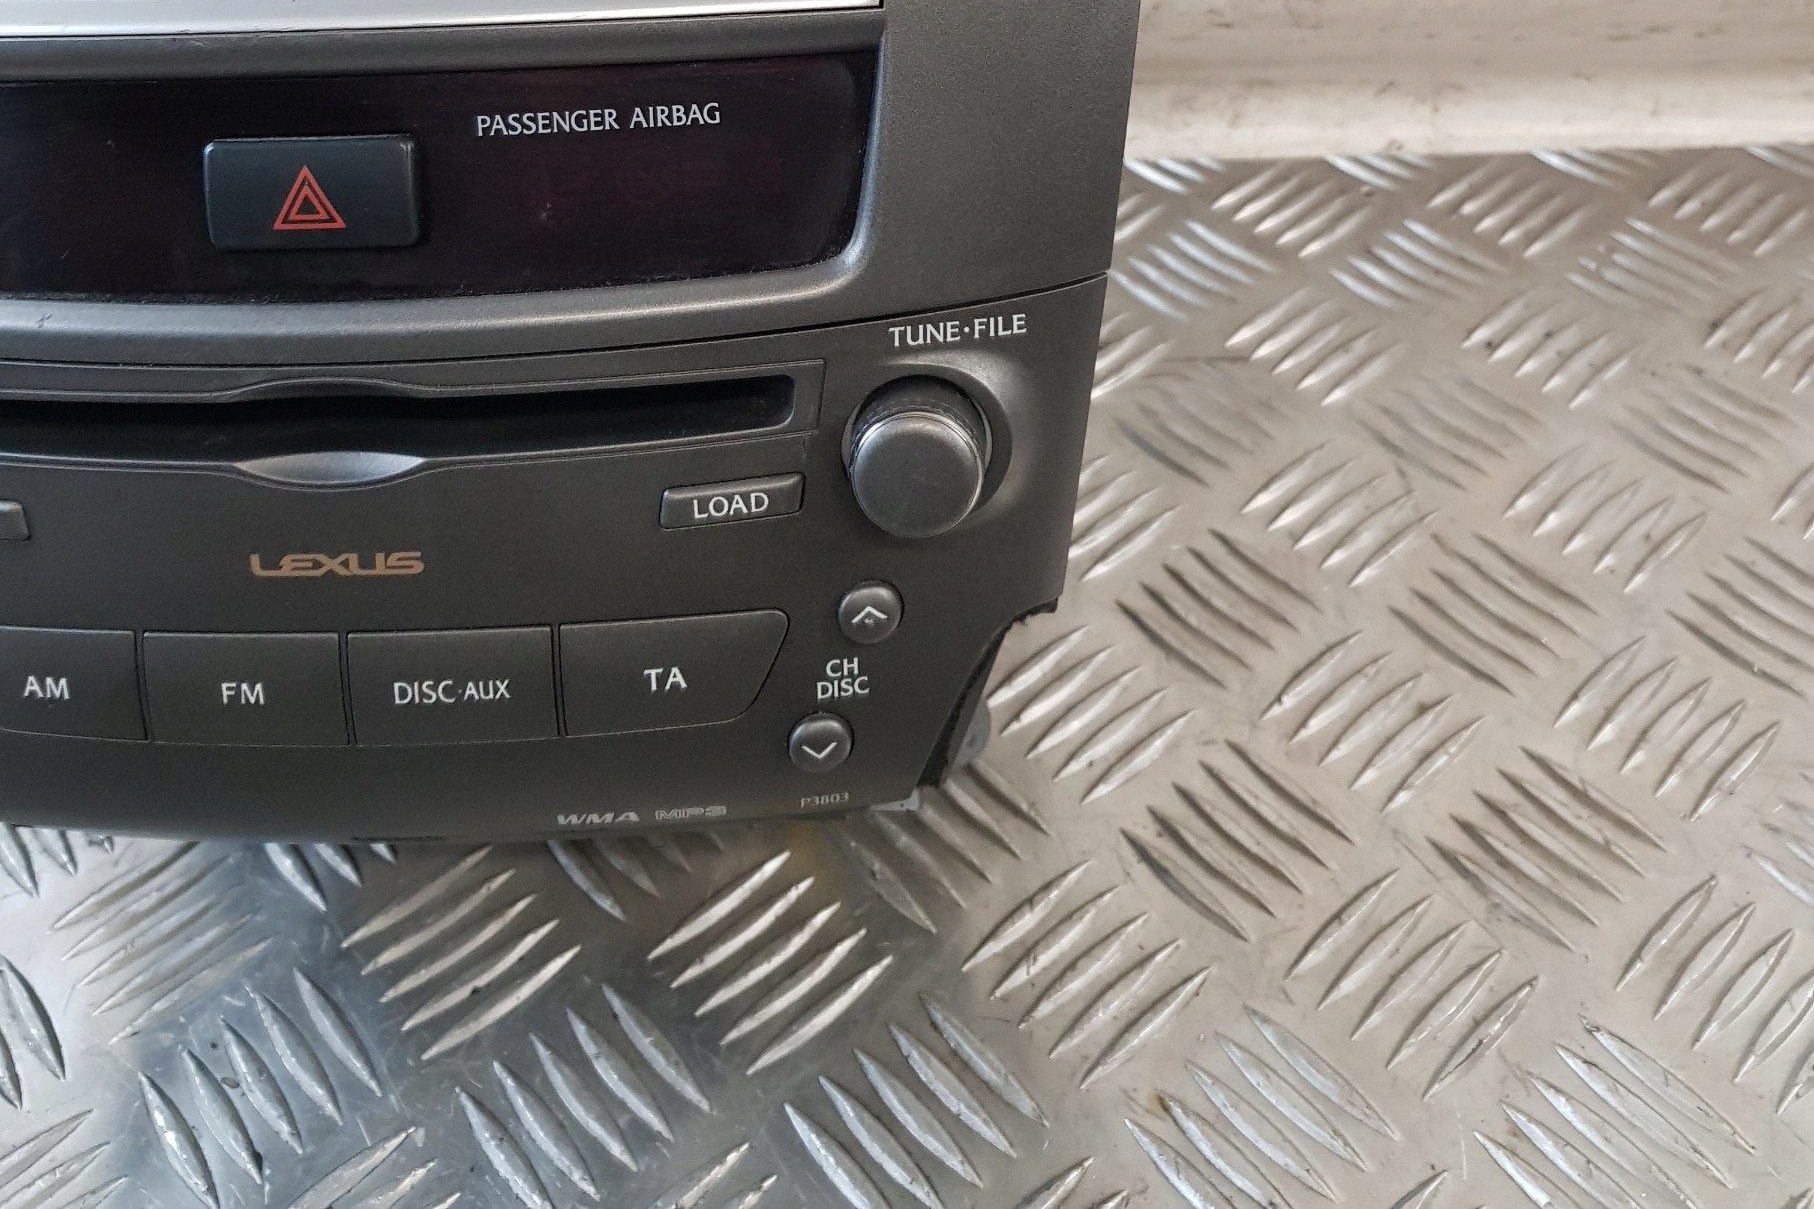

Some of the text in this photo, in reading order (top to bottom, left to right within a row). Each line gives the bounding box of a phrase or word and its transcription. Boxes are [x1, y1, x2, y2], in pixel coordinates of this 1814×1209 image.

[475, 101, 722, 138] PASSENGER AIRBAG
[692, 491, 770, 520] LOAD
[248, 551, 425, 578] LEXUS
[643, 666, 689, 693] TA
[825, 656, 860, 679] CH
[22, 675, 71, 701] AM
[221, 681, 266, 706] FM
[815, 676, 870, 701] DISC
[800, 791, 850, 809] P3803
[556, 804, 728, 825] WMA MP3
